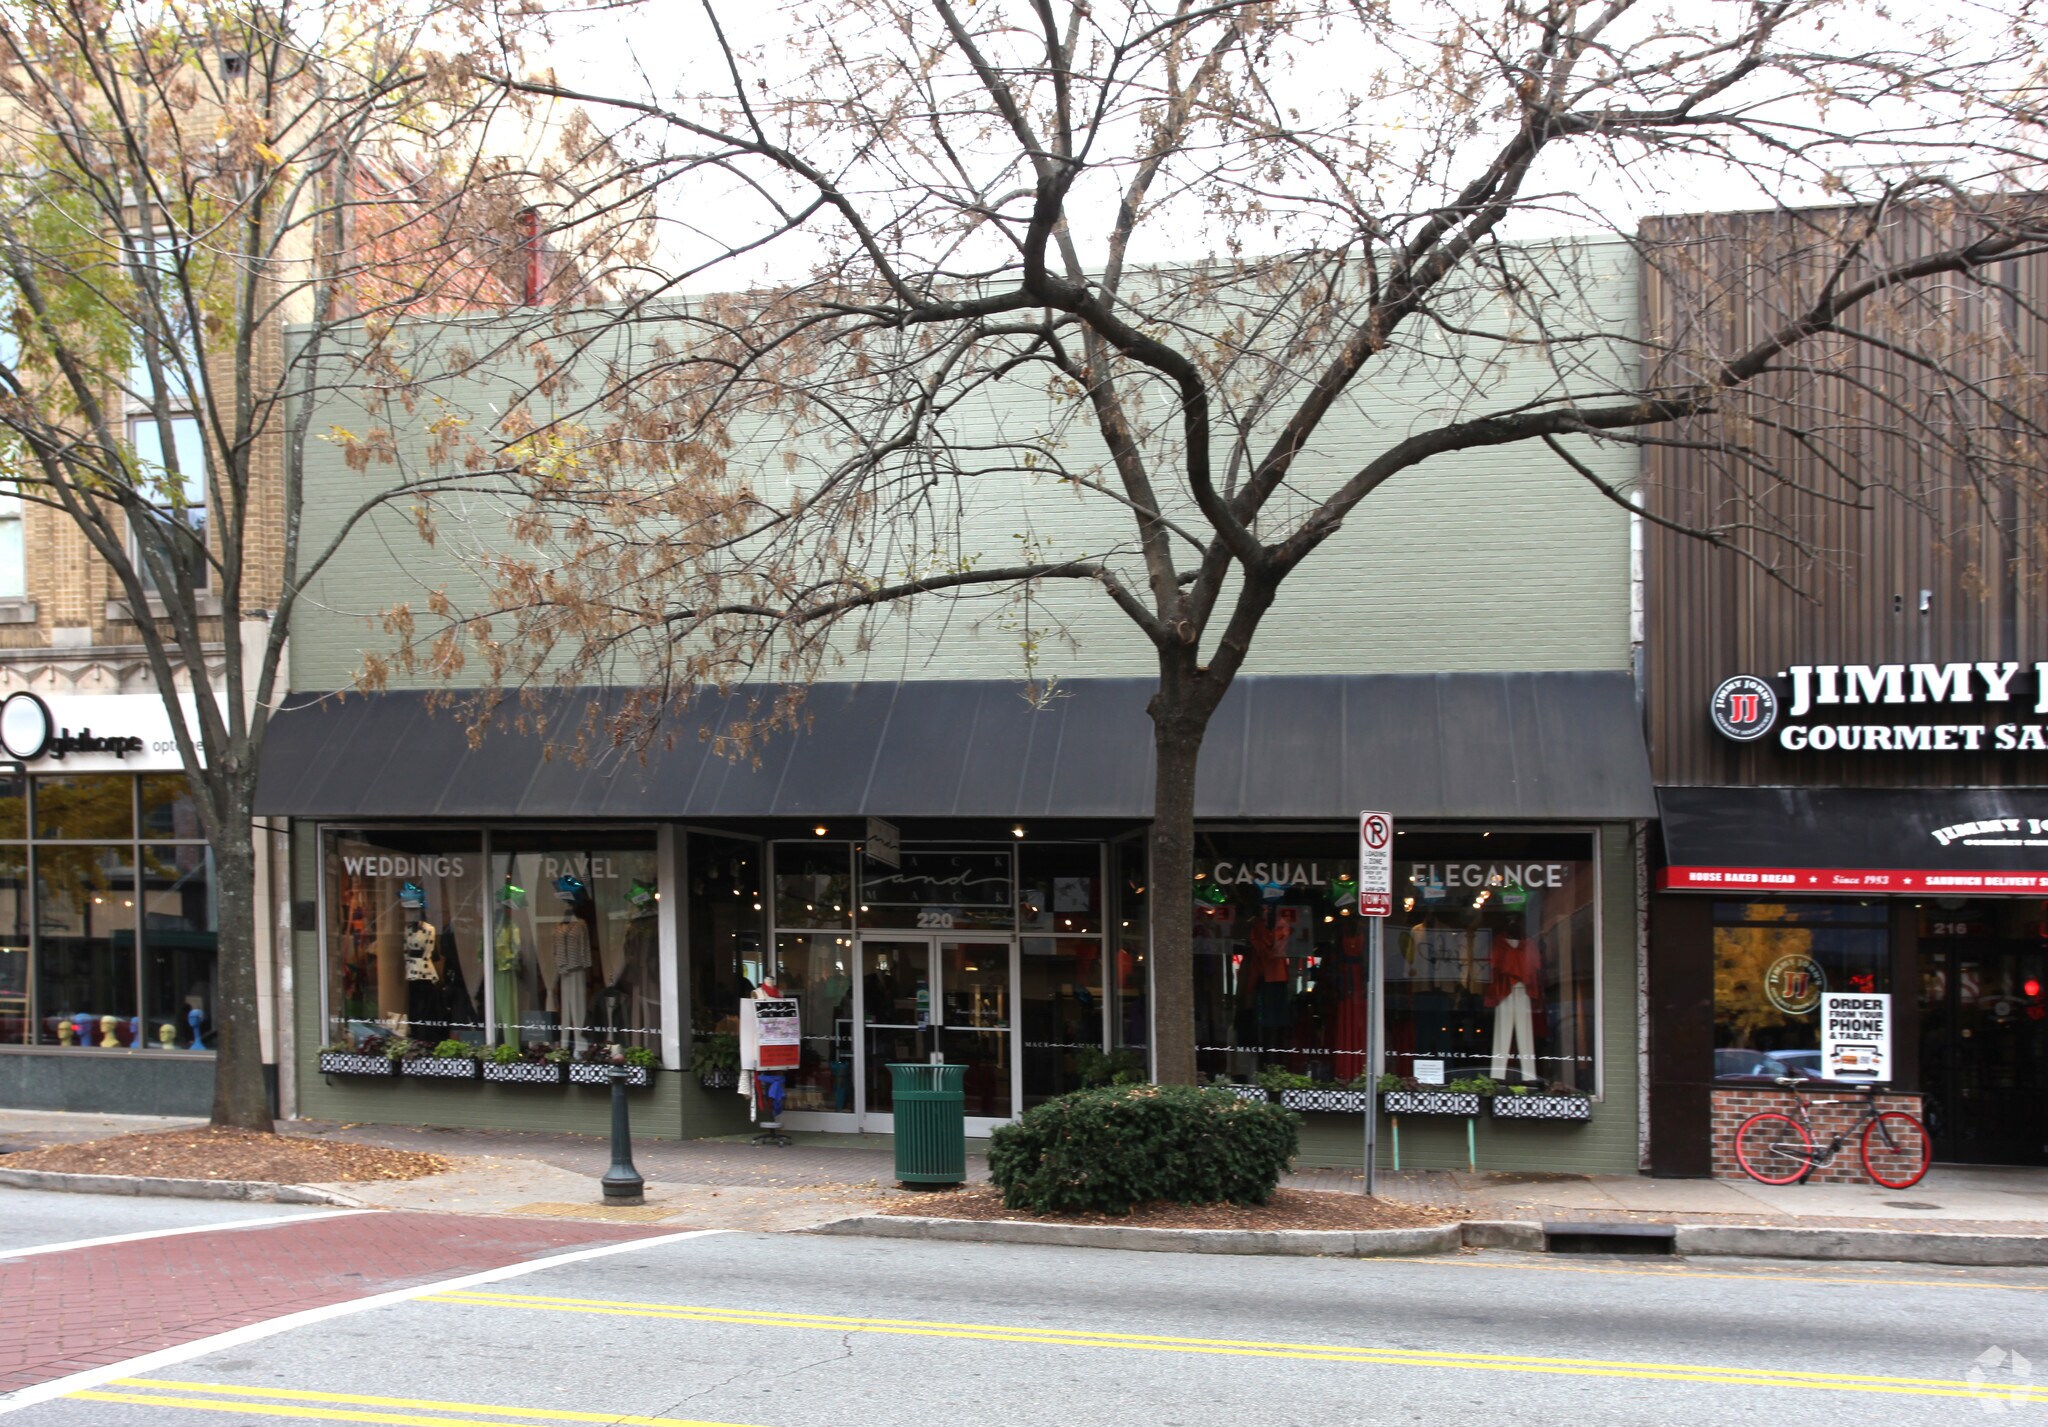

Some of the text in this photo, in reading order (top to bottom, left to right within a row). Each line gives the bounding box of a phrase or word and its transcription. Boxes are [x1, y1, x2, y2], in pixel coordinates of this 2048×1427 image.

[1716, 680, 1773, 708] JIMMY JOHN'S
[1790, 662, 2019, 716] JIMMY
[1730, 694, 1759, 723] JJ
[1780, 724, 2048, 750] GOURMET SA
[1931, 819, 2020, 846] JIMMY
[343, 856, 465, 878] WEDDINGS
[858, 868, 1013, 886] and
[1214, 862, 1326, 885] CASUAL
[1412, 864, 1563, 888] ELEGANCE
[1689, 872, 1722, 882] HOUSE
[1724, 873, 1759, 882] BAKED
[1761, 874, 1796, 883] BREAD
[1984, 877, 2037, 886] DELIVERY
[1362, 894, 1389, 904] TOW-IN
[916, 912, 953, 928] 220
[1934, 922, 1967, 934] 216
[1782, 971, 1810, 998] JJ
[1829, 998, 1883, 1010] ORDER
[1829, 1010, 1856, 1018] FROM
[1829, 1019, 1883, 1031] PHONE
[1829, 1032, 1838, 1040] &
